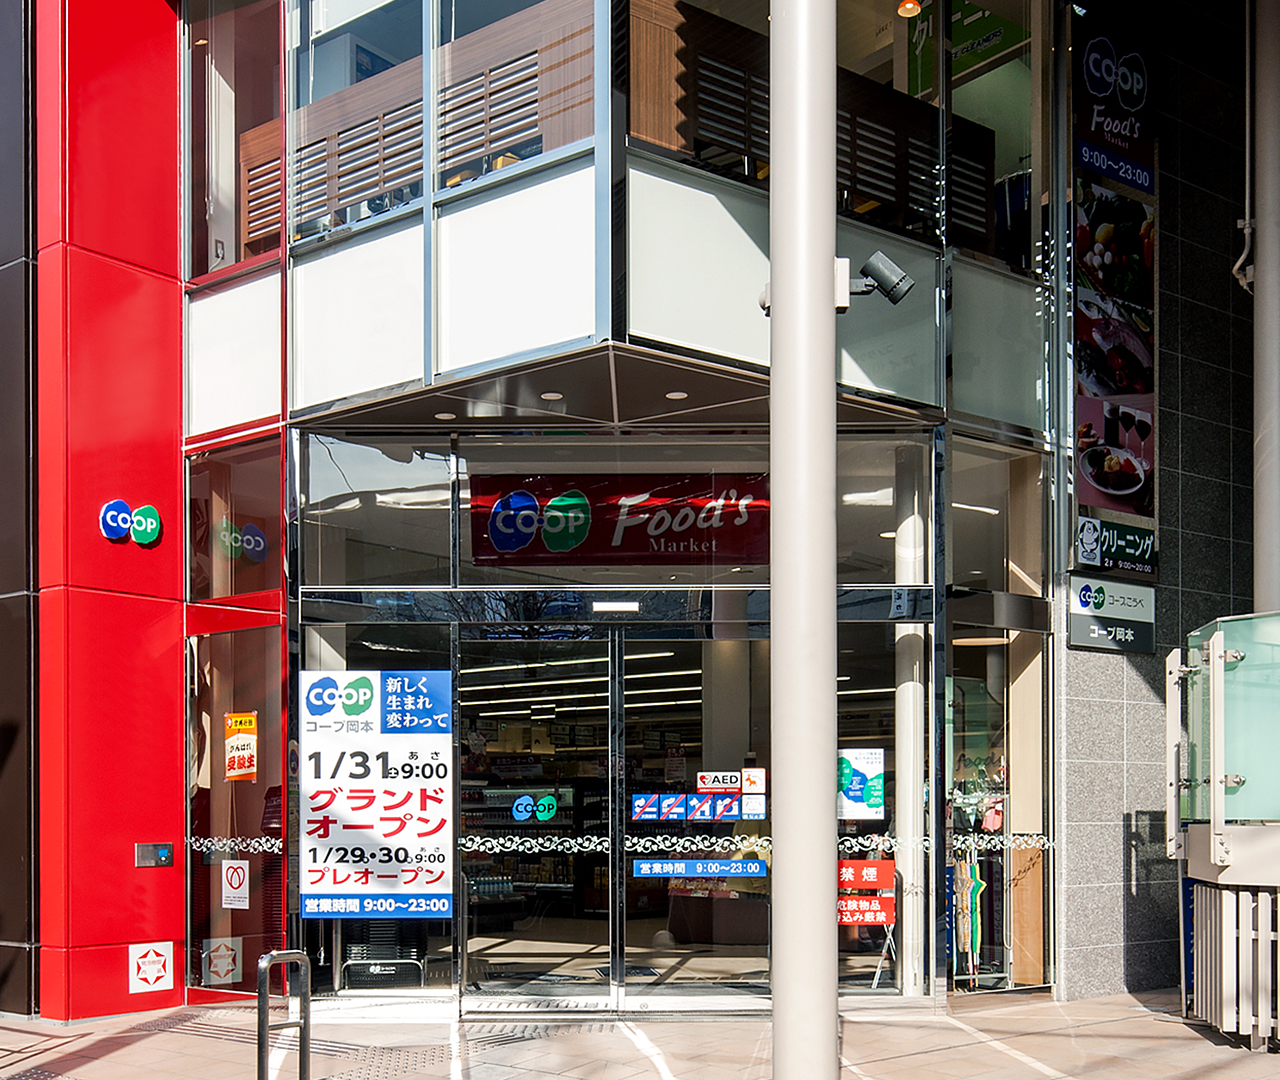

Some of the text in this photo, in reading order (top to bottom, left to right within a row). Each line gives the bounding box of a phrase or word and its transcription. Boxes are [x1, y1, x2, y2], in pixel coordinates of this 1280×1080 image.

[1103, 131, 1129, 150] Market
[611, 489, 754, 547] Food's
[649, 537, 718, 553] Market
[1101, 527, 1154, 559] クリーニング
[1089, 625, 1135, 643] コープ岡本
[385, 676, 428, 694] 新しく
[385, 695, 433, 711] 生まれ
[306, 720, 374, 733] コープ岡本
[385, 712, 449, 729] 変わって
[227, 754, 255, 772] 受験生
[400, 763, 448, 780] 9:00
[711, 775, 739, 785] AED
[308, 786, 445, 812] グランド
[305, 813, 448, 839] オープン
[307, 866, 446, 886] プレオープン
[639, 863, 686, 875] 営業時間
[840, 866, 878, 882] 禁煙
[305, 898, 360, 913] 営業時間
